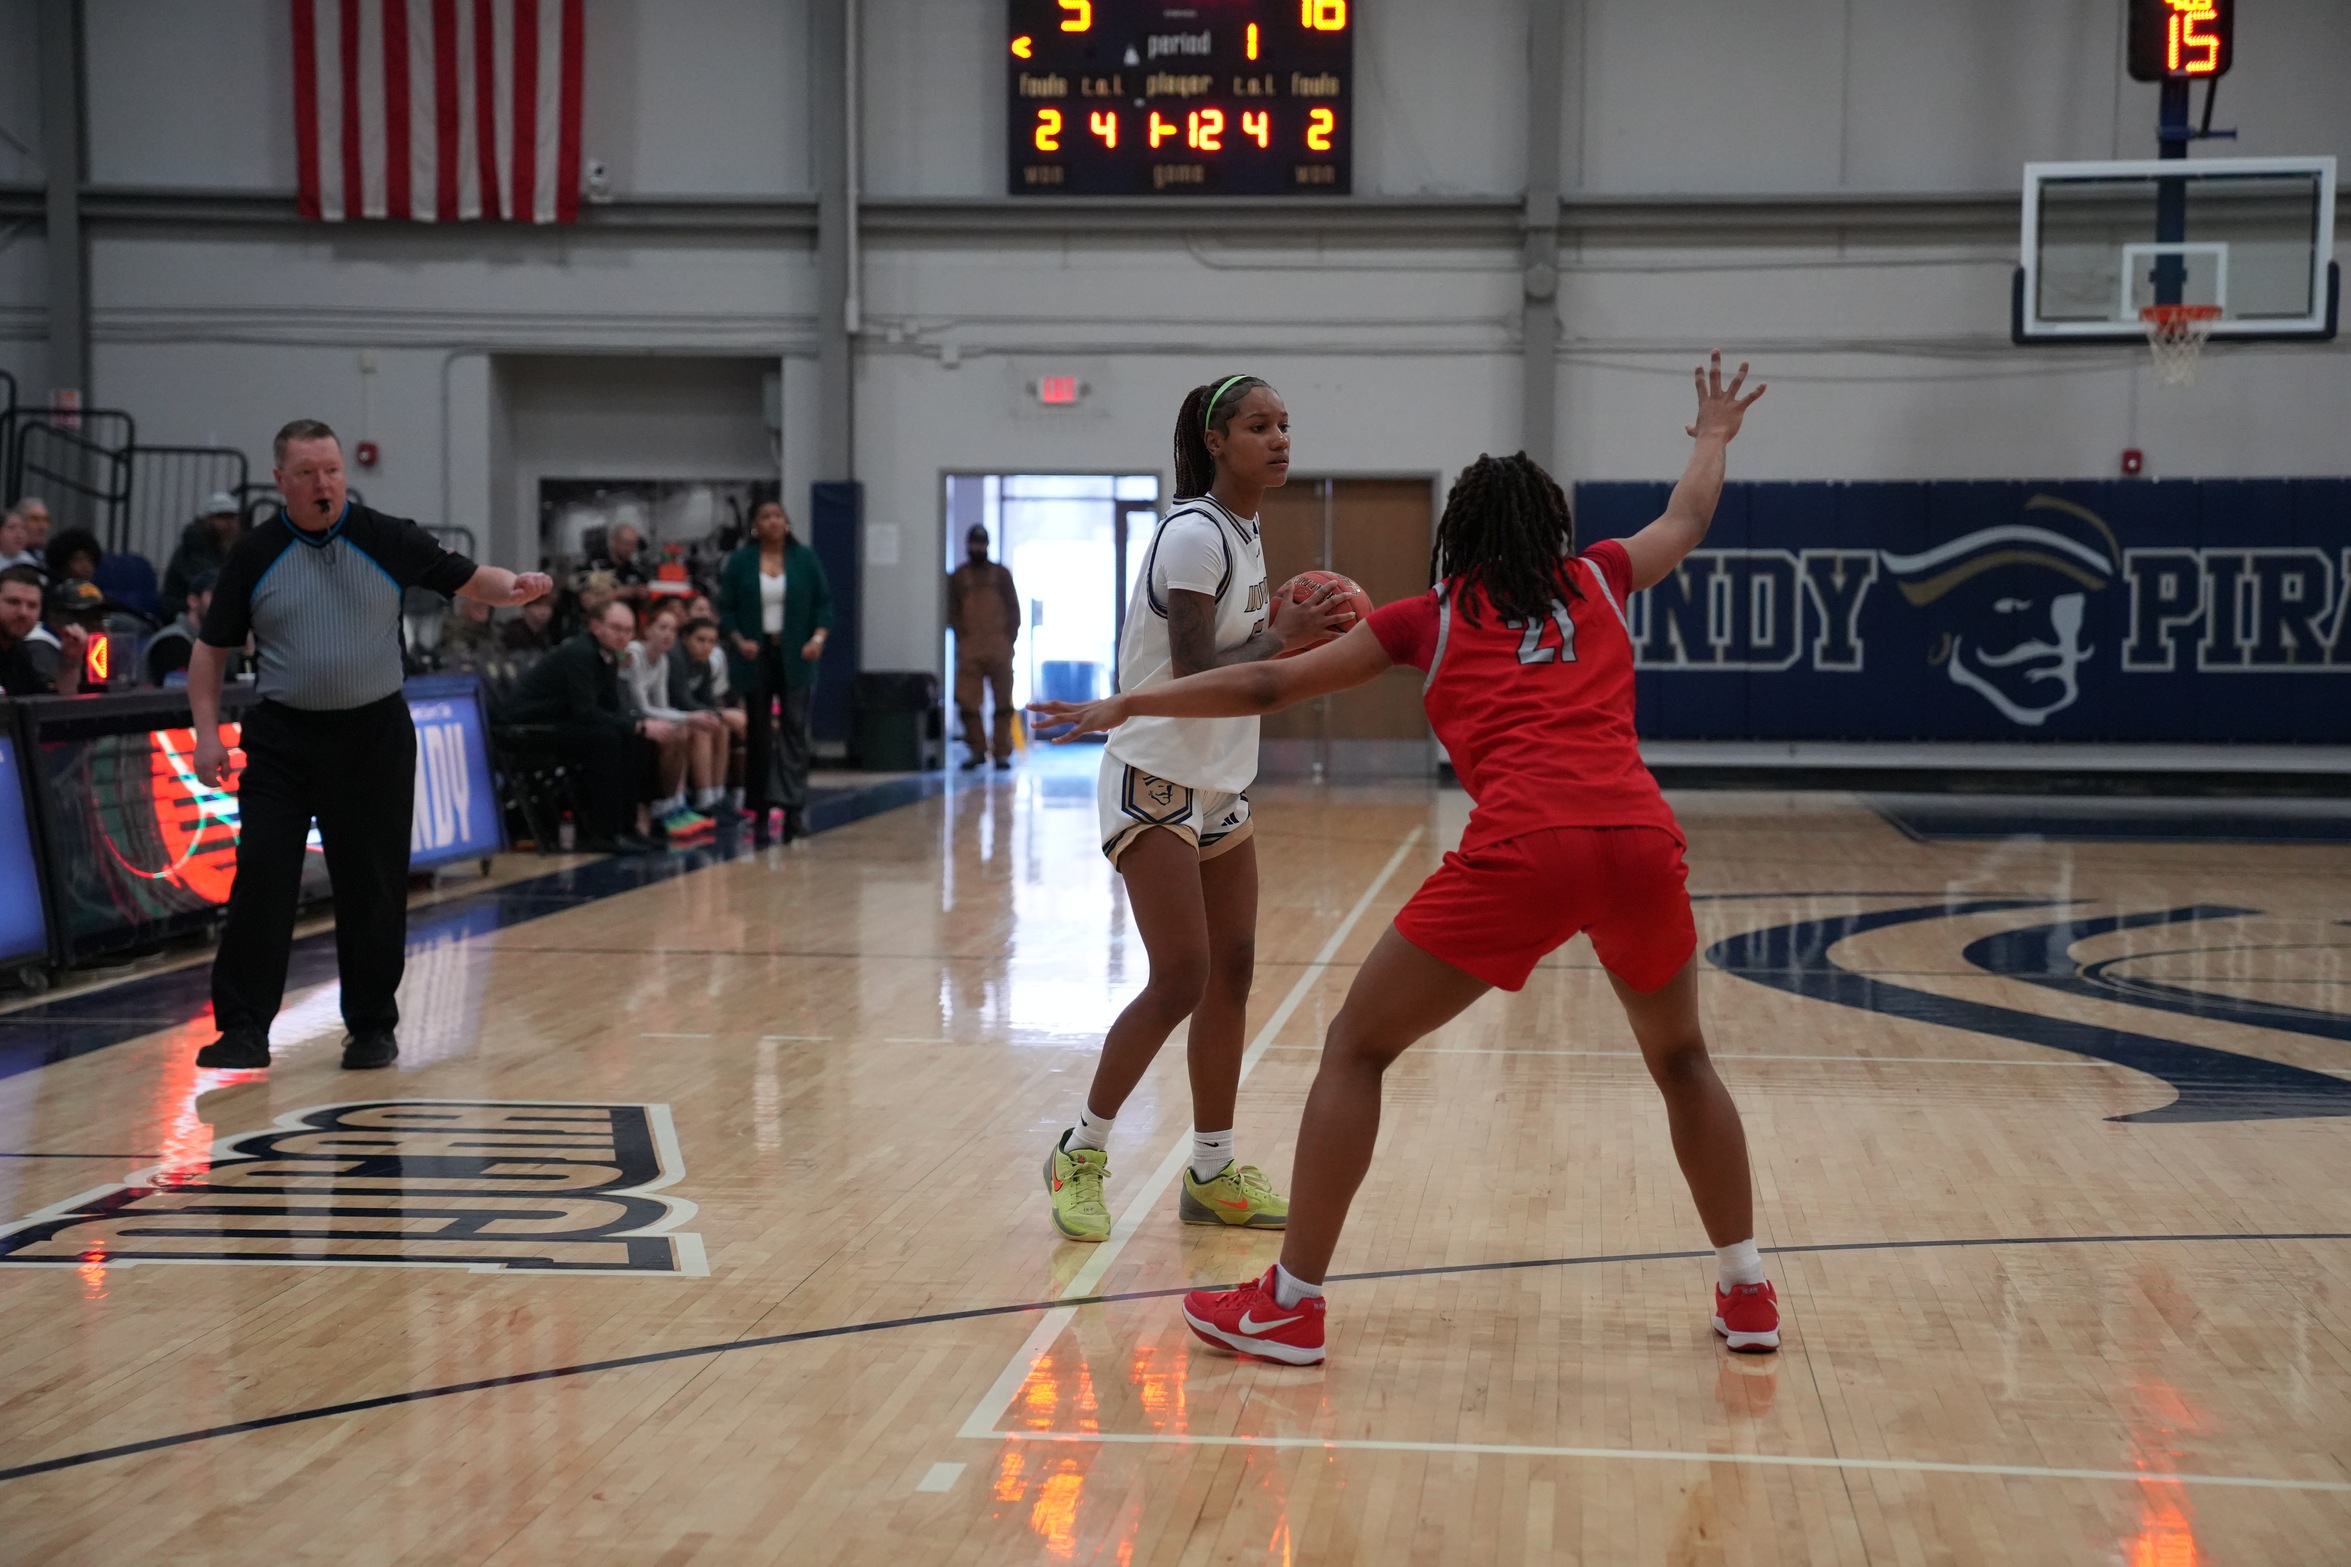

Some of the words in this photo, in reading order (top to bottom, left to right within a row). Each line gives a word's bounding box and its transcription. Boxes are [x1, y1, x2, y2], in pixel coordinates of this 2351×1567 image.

[1149, 30, 1211, 59] period
[1247, 22, 1258, 60] 1
[2168, 9, 2220, 72] 15
[1035, 109, 1061, 151] 2
[1090, 111, 1117, 149] 4
[1242, 111, 1268, 149] 4
[1307, 109, 1334, 151] 2
[2121, 547, 2351, 672] PIR
[1507, 598, 1577, 665] 21
[411, 722, 470, 853] NDY
